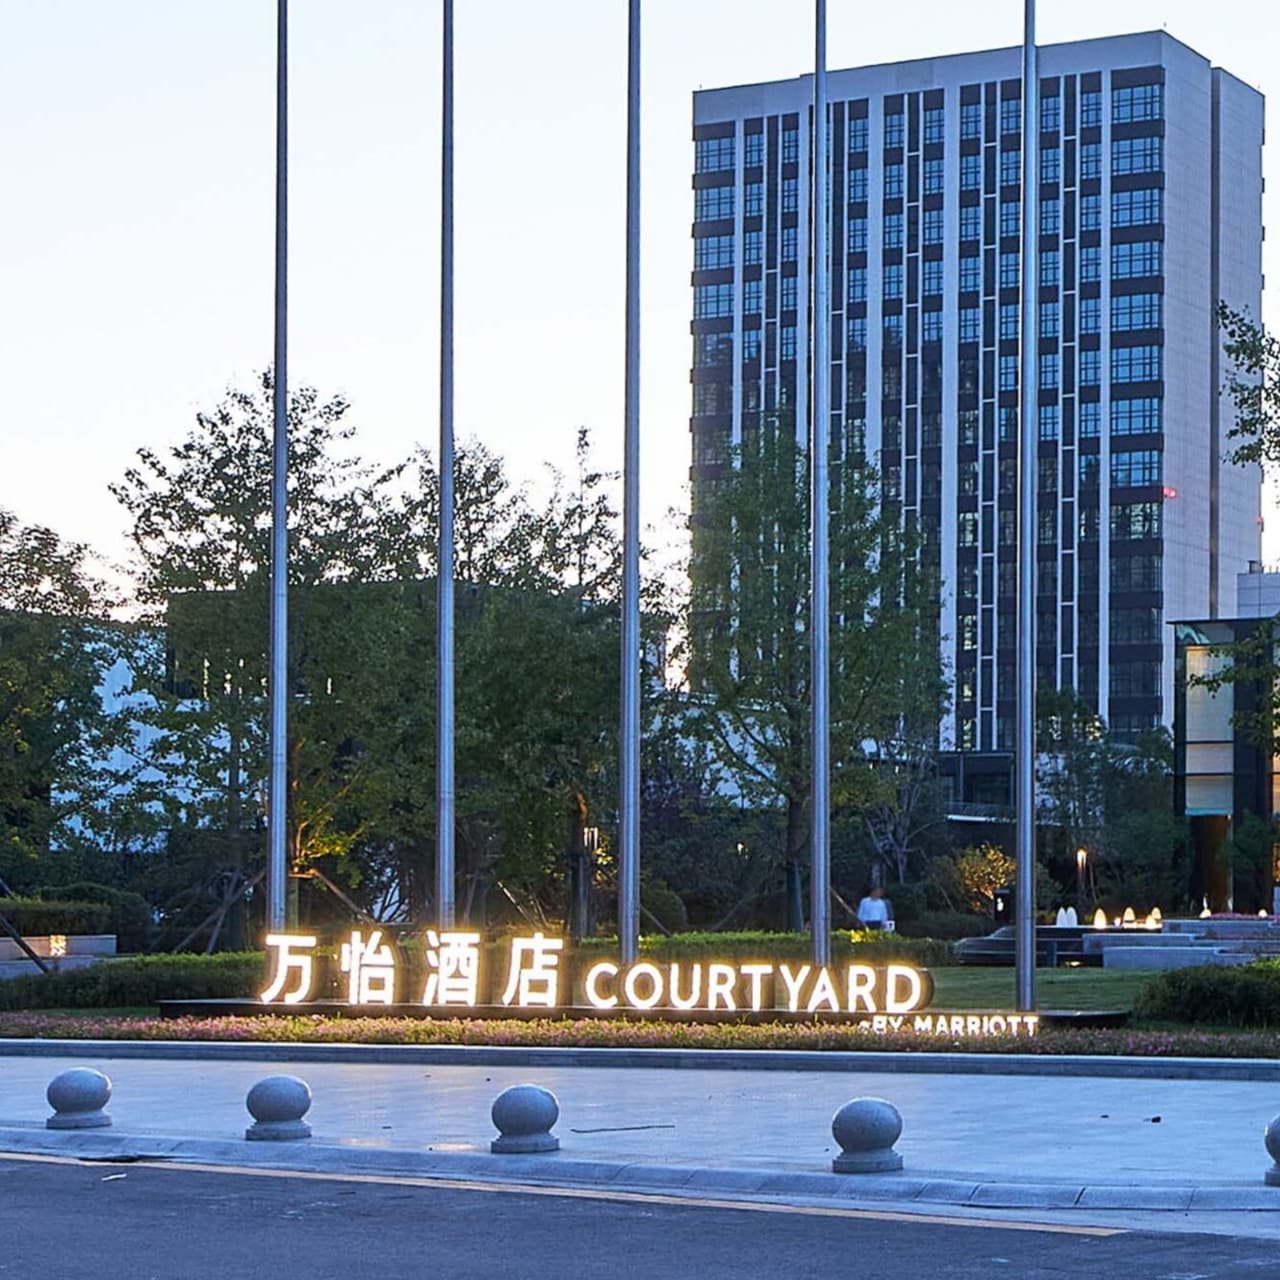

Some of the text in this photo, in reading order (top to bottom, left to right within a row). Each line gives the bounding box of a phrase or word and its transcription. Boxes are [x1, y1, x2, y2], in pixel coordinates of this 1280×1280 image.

[260, 930, 922, 1013] 万怡酒店 COURTYARD
[872, 1015, 1039, 1037] BY MARRIOTT
